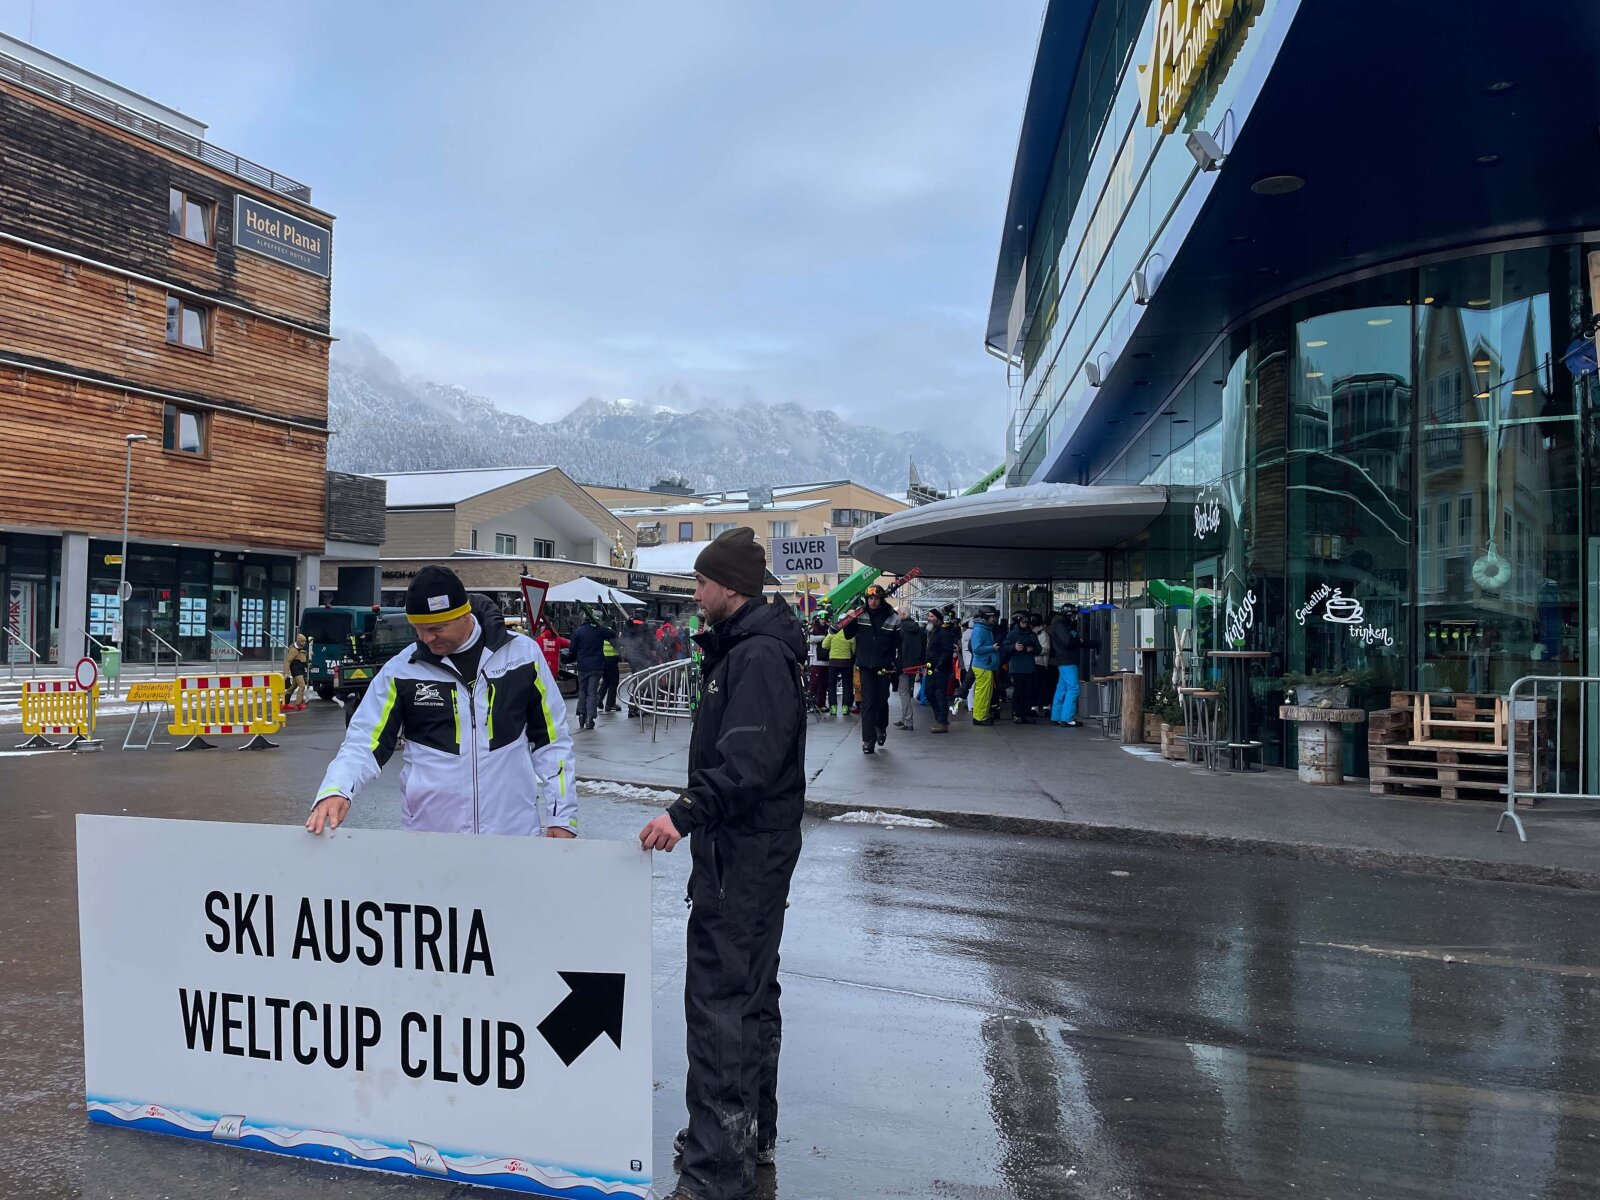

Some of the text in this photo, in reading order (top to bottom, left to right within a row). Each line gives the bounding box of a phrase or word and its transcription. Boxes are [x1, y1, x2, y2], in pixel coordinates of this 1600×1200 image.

[246, 208, 321, 253] Hotel Planai
[256, 239, 311, 263] ALPEFFECT HOTELS
[782, 540, 826, 554] SILVER
[785, 557, 824, 571] CARD
[1224, 589, 1257, 649] Vintage
[1348, 623, 1394, 647] trinken
[210, 648, 235, 656] RE/MAX
[136, 684, 174, 692] Umleitung
[204, 890, 494, 976] SKI AUSTRIA
[179, 988, 525, 1090] WELTCUP CLUB
